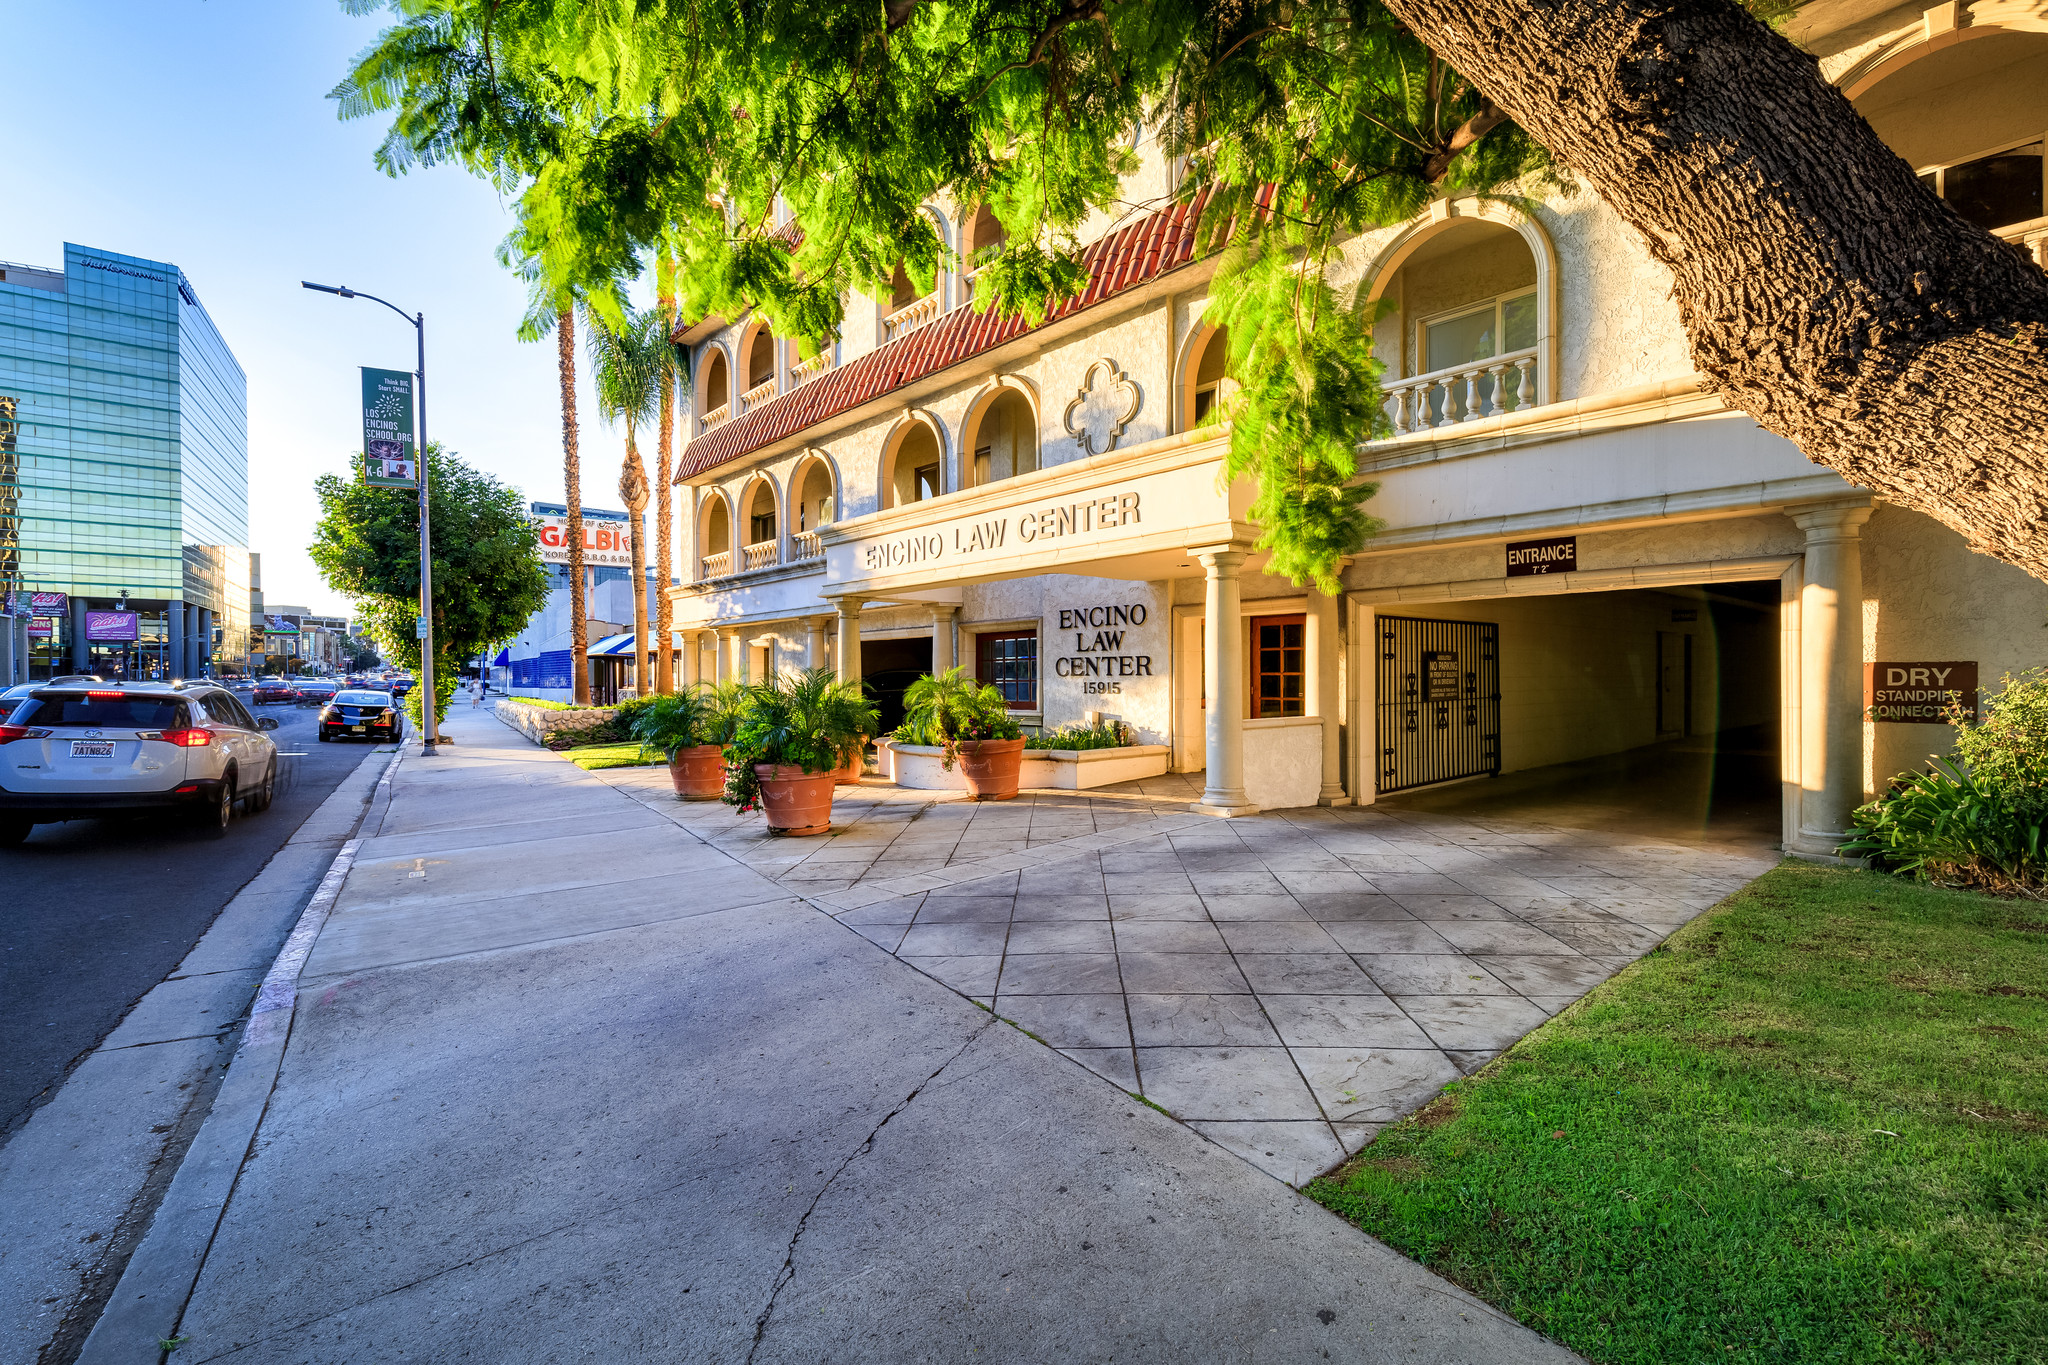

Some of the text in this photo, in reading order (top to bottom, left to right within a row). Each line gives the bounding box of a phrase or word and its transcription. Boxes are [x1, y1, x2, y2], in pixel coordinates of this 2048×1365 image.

[384, 378, 398, 386] Think
[365, 408, 380, 419] LOS
[366, 418, 399, 431] ENCINOS
[366, 429, 412, 442] SCHOOL.ORG
[366, 465, 383, 478] K-6
[864, 491, 1142, 571] ENCINO LAW CENTER
[1508, 544, 1574, 565] ENTRANCE
[91, 614, 132, 630] aahs!
[1059, 604, 1147, 629] ENCINO
[1076, 631, 1125, 652] LAW
[1055, 655, 1152, 677] CENTER
[1430, 662, 1458, 670] NO PARKING
[1887, 667, 1953, 686] DRY
[1083, 682, 1121, 694] 15915
[73, 746, 112, 756] 7ATN826
